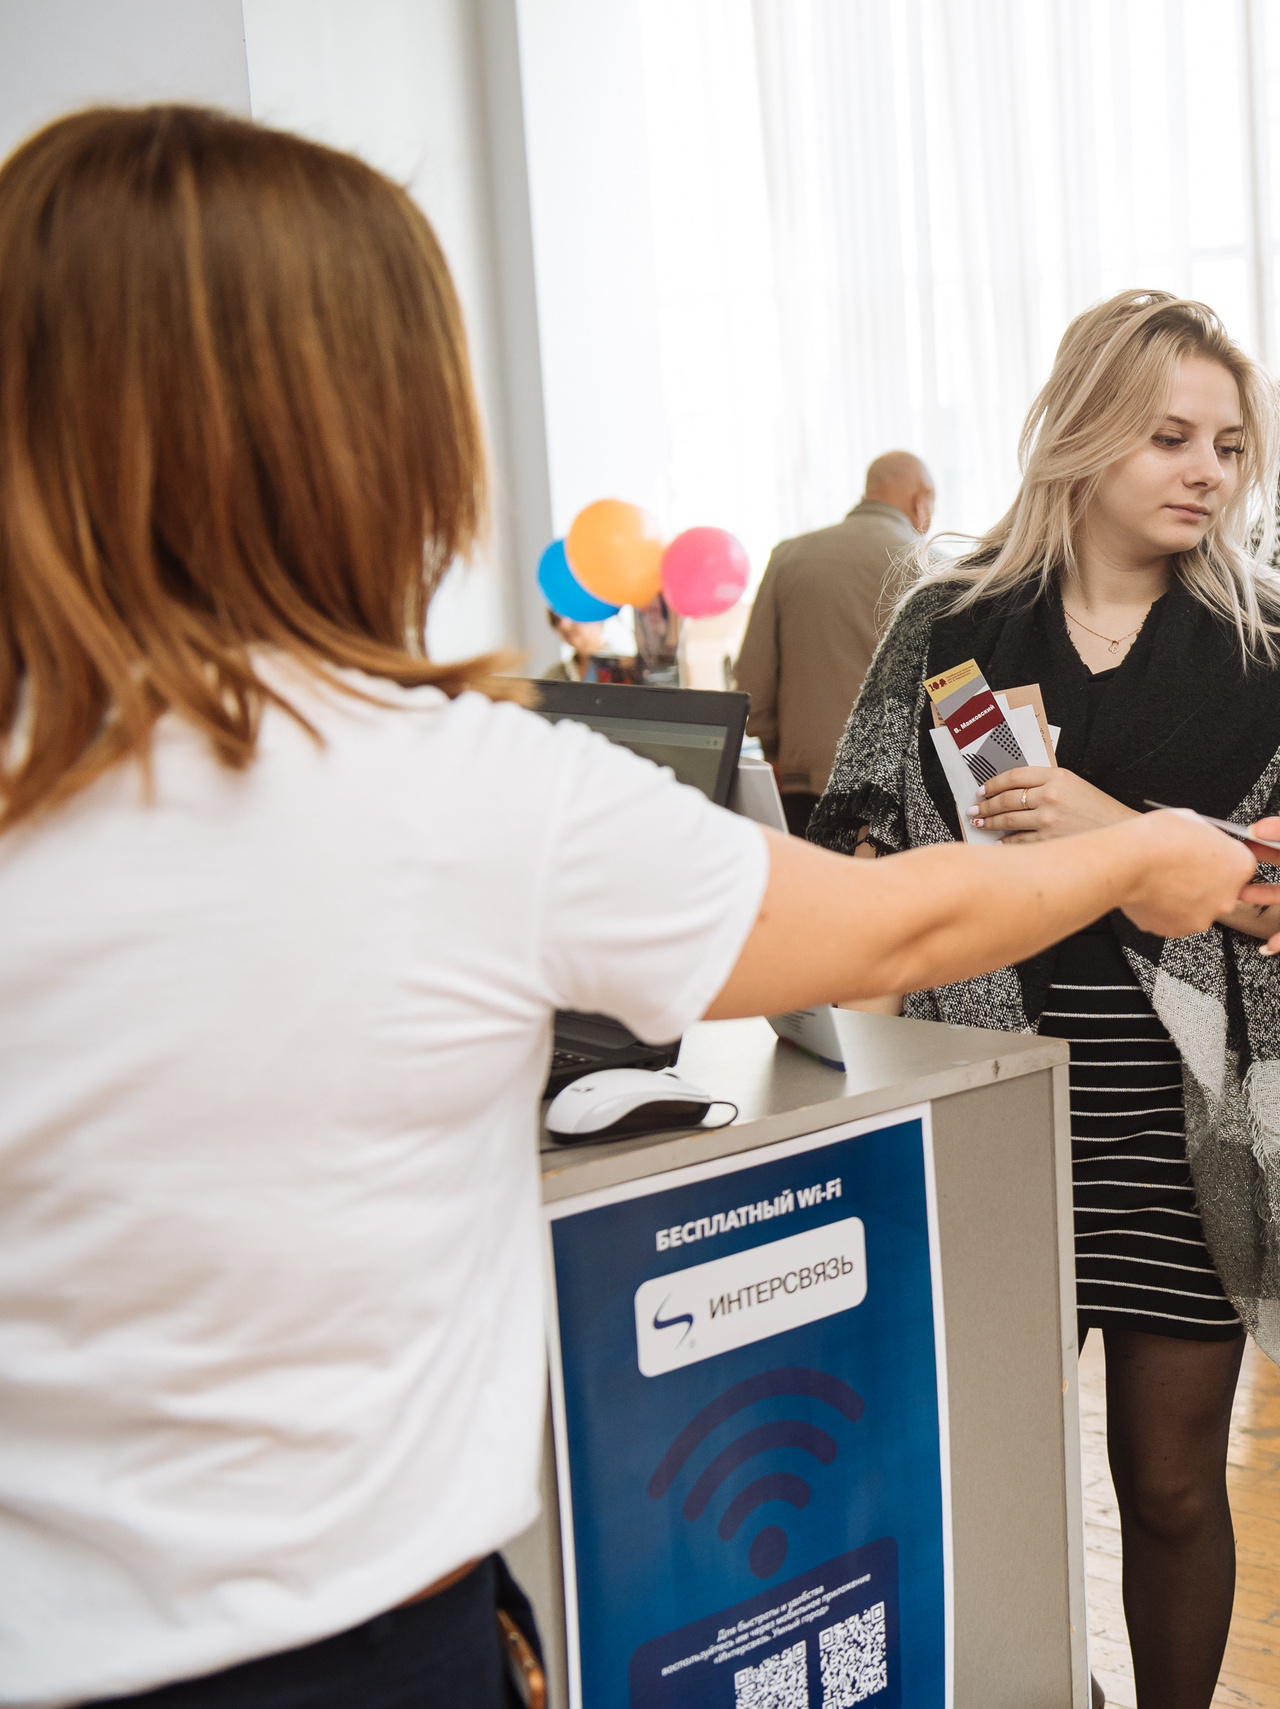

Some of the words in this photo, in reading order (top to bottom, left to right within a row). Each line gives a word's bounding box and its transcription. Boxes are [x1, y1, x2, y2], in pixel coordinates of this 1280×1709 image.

[960, 704, 996, 729] Маяковский
[656, 1189, 795, 1252] БЕСПЛАТНЫЙ
[796, 1178, 842, 1208] Wi-Fi
[709, 1255, 854, 1320] ИНТЕРСВЯЗЬ
[661, 1640, 735, 1677] воспользуйтесь
[749, 1619, 776, 1637] через
[775, 1597, 821, 1625] мобильное
[821, 1573, 871, 1603] приложение
[717, 1626, 737, 1643] Для
[737, 1606, 780, 1632] быстроты
[787, 1585, 824, 1614] удобства
[772, 1617, 800, 1638] Умный
